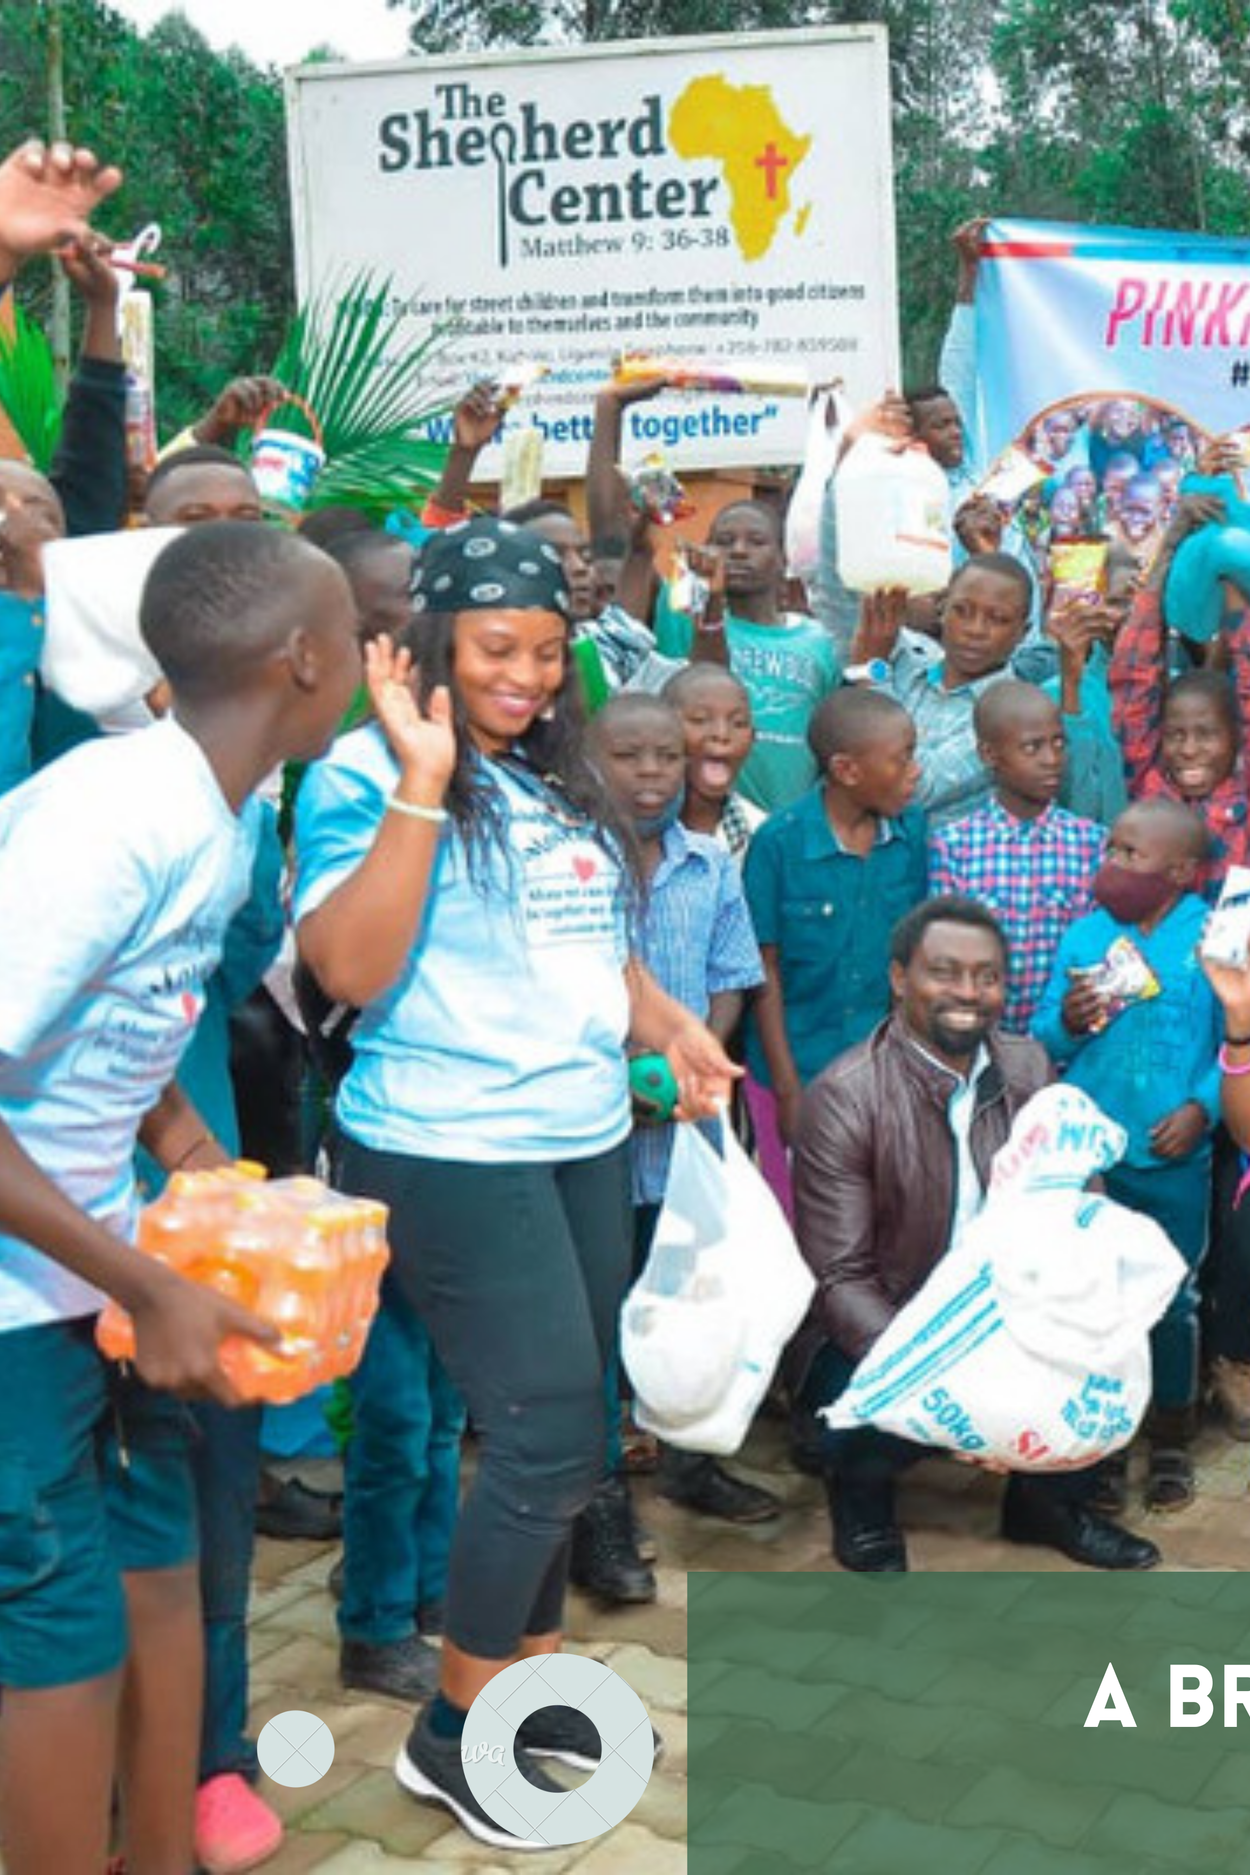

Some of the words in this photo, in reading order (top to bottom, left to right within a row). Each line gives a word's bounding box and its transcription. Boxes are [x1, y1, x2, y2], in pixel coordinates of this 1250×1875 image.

[435, 82, 506, 119] The
[379, 95, 665, 173] Shepherd
[508, 168, 719, 226] Center
[520, 233, 624, 257] Matthew
[631, 233, 654, 251] 9:
[660, 226, 730, 250] 36-38
[581, 291, 608, 309] and
[610, 286, 685, 307] transform
[765, 282, 805, 305] good
[807, 282, 865, 300] citizens
[508, 317, 524, 334] to
[526, 312, 611, 334] themselves
[614, 310, 643, 331] and
[645, 310, 671, 329] the
[674, 309, 759, 332] community
